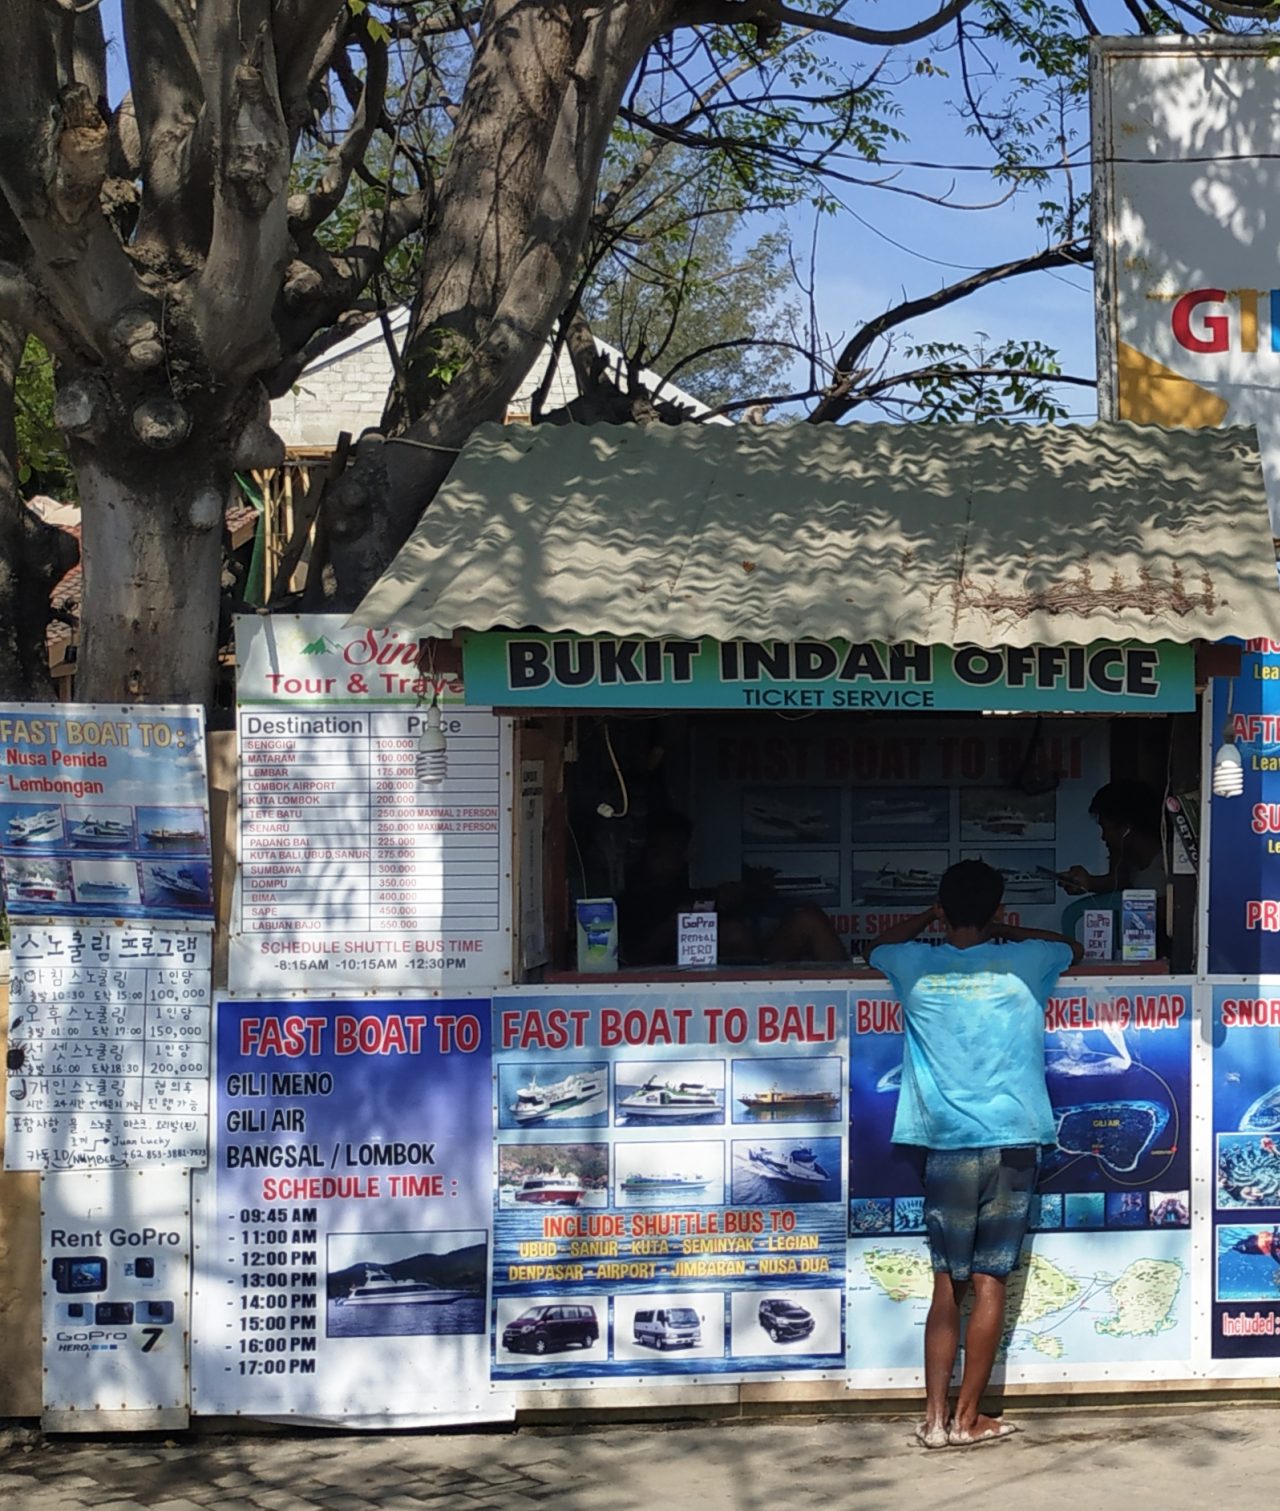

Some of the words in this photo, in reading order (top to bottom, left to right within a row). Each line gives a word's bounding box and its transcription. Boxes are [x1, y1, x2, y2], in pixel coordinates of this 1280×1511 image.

[506, 639, 701, 691] BUKIT
[718, 639, 934, 684] INDAH
[952, 645, 1160, 698] OFFICE
[266, 673, 337, 694] Tour
[347, 674, 369, 694] &
[742, 689, 824, 707] TICKET
[832, 690, 934, 708] SERVICE
[0, 720, 58, 746] FAST
[66, 721, 131, 748] BOAT
[248, 717, 362, 734] Destination
[6, 749, 48, 767] Nusa
[52, 751, 107, 767] Penida
[8, 775, 104, 798] Lembongan
[248, 782, 290, 791] LOMBOK
[293, 782, 336, 791] AIRPORT
[249, 810, 274, 819] TETE
[276, 810, 302, 819] BATU
[463, 808, 498, 817] PERSON
[251, 866, 302, 874] SUMBAWA
[252, 893, 276, 902] BIMA
[252, 921, 293, 930] LABUAN
[261, 941, 341, 953] SCHEDULE
[344, 941, 411, 953] SHUTTLE
[415, 940, 445, 953] BUS
[449, 940, 484, 952] TIME
[1135, 994, 1185, 1029] MAP
[241, 1016, 327, 1057] FAST
[334, 1015, 427, 1056] BOAT
[435, 1014, 481, 1054] TO
[502, 1008, 591, 1050] FAST
[599, 1007, 693, 1047] BOAT
[703, 1007, 748, 1046] TO
[757, 1005, 836, 1045] BALI
[227, 1073, 266, 1096] GILI
[272, 1072, 333, 1096] MENO
[227, 1109, 266, 1133] GILI
[271, 1109, 305, 1132] AIR
[226, 1145, 325, 1168] BANGSAL
[346, 1143, 435, 1166] LOMBOK
[262, 1178, 380, 1200] SCHEDULE
[240, 1208, 287, 1223] 09:45
[291, 1208, 318, 1222] AM
[544, 1216, 626, 1238] INCLUDE
[632, 1213, 718, 1237] SHUTTLE
[723, 1211, 764, 1235] BUS
[770, 1210, 796, 1232] TO
[51, 1230, 103, 1248] Rent
[109, 1228, 181, 1247] GoPro
[241, 1229, 287, 1245] 11:00
[291, 1229, 318, 1244] AM
[570, 1240, 618, 1257] SANUR
[682, 1237, 754, 1254] SEMINYAK
[768, 1235, 820, 1252] LEGIAN
[241, 1251, 287, 1267] 12:00
[291, 1251, 318, 1266] PM
[508, 1263, 584, 1280] DENPASAR
[671, 1260, 746, 1278] JIMBARAN
[240, 1294, 286, 1310] 14:00
[290, 1294, 317, 1309] PM
[56, 1331, 127, 1342] GoPro
[141, 1328, 164, 1352] 7
[239, 1359, 286, 1375] 17:00
[290, 1359, 317, 1374] PM
